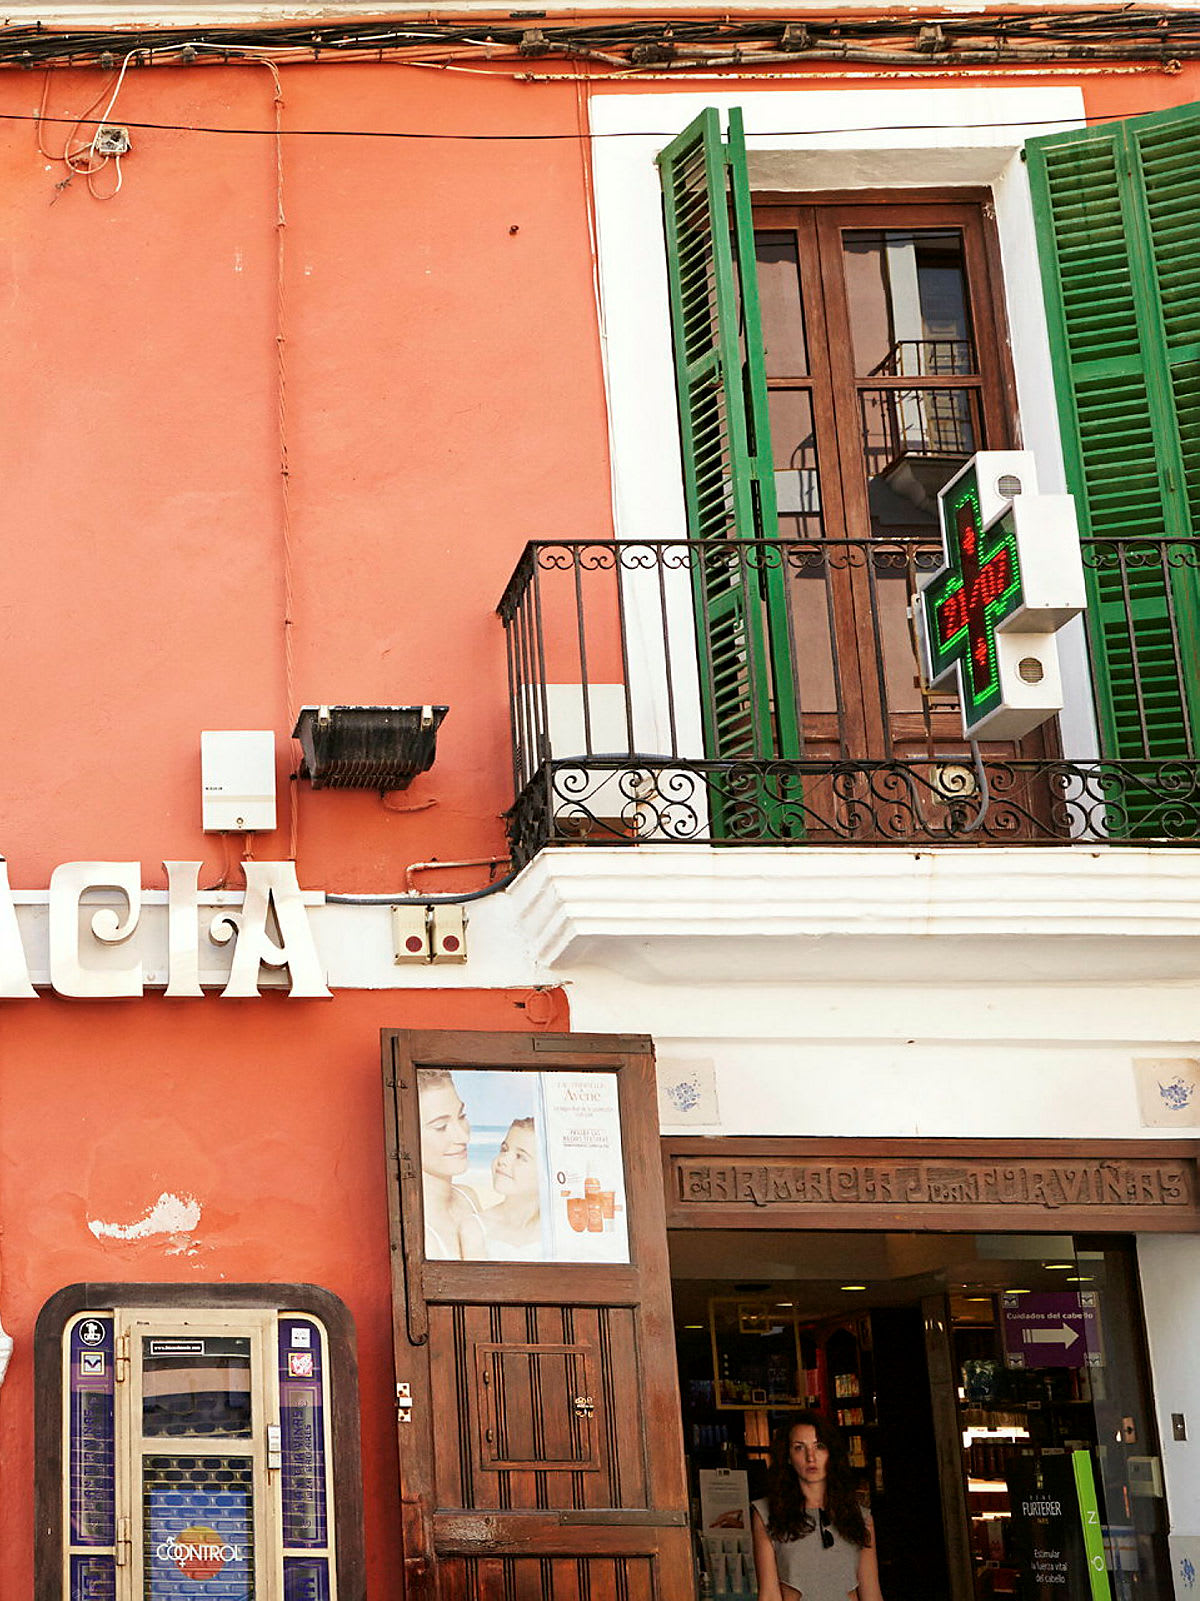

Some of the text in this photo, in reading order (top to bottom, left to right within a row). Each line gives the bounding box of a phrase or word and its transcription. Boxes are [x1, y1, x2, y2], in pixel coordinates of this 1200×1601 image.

[677, 1166, 892, 1208] FARMACIA
[968, 1161, 1187, 1210] TURVIÑAS
[1006, 1312, 1046, 1320] Cuidados
[1047, 1312, 1060, 1320] del
[1022, 1501, 1062, 1516] FURTERER
